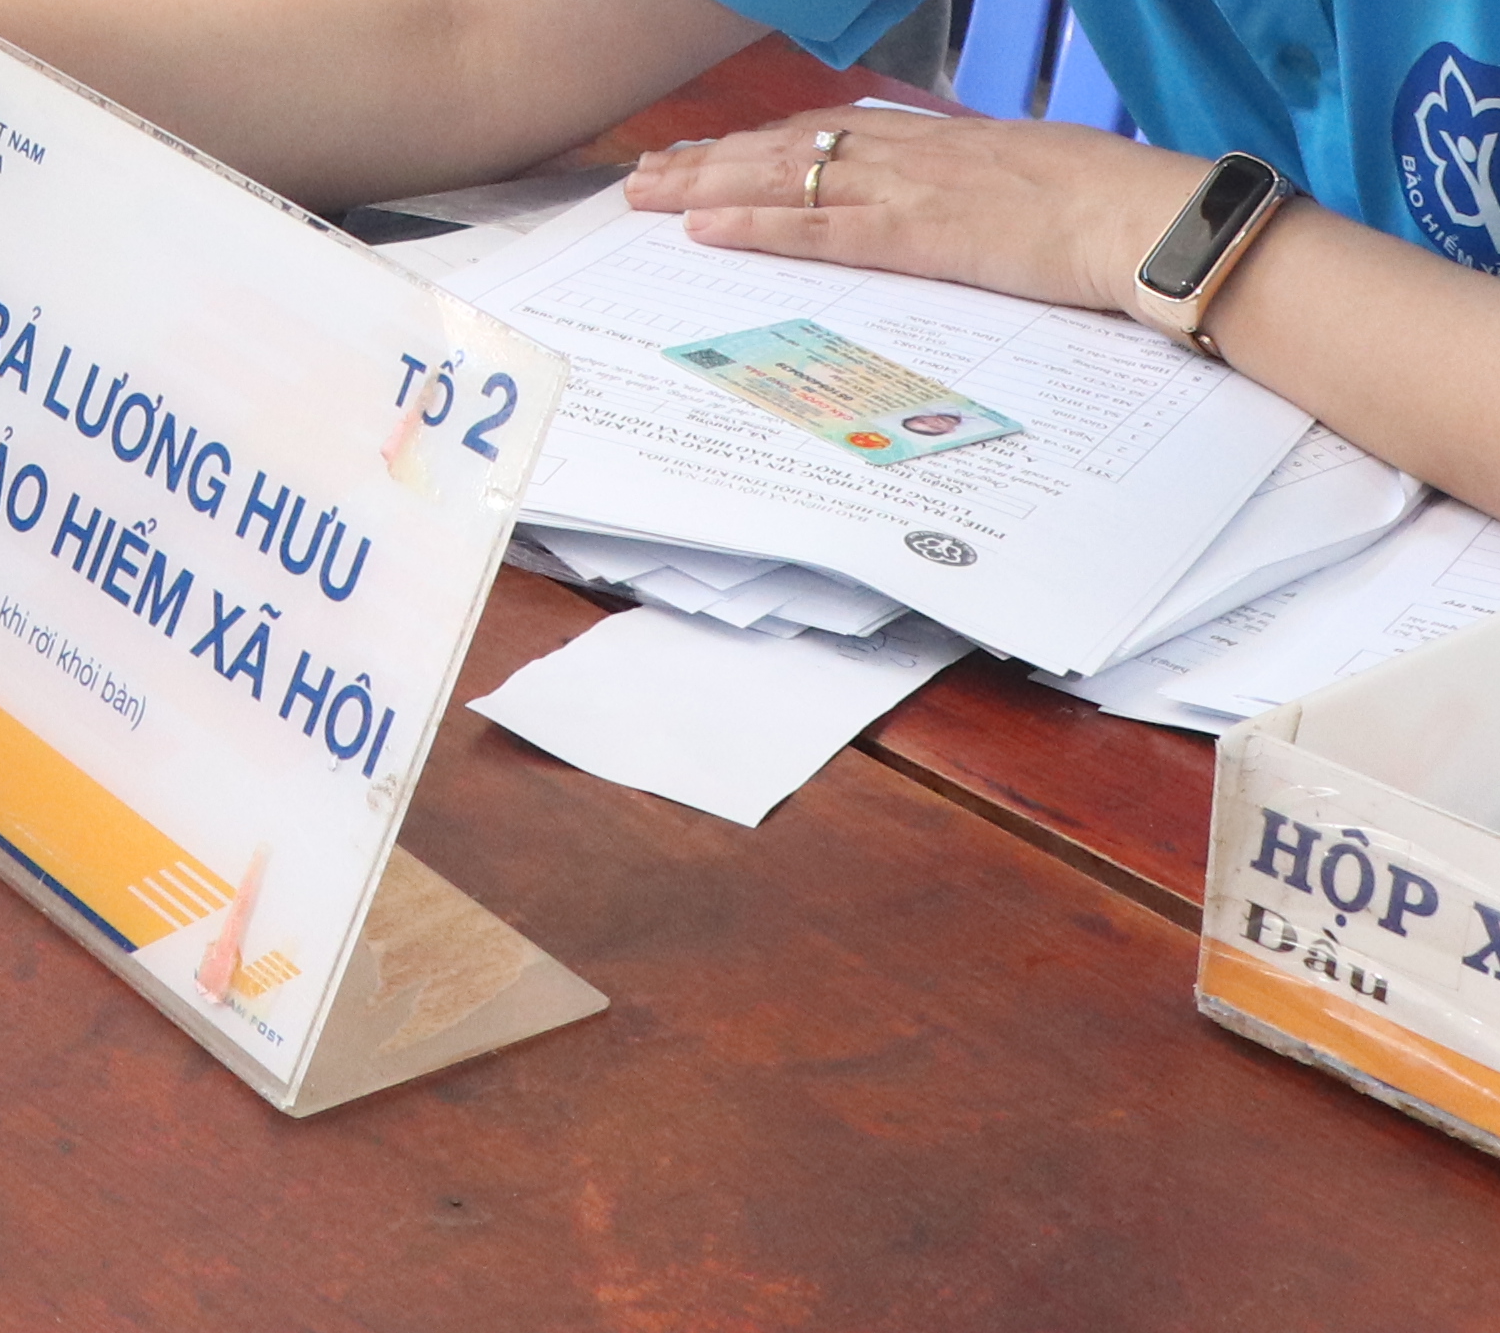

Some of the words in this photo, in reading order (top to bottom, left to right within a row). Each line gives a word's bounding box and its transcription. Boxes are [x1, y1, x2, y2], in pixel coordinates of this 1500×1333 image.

[7, 130, 45, 164] NAM
[44, 347, 230, 516] LƯƠNG
[236, 471, 370, 601] HƯU
[461, 372, 517, 461] 2
[27, 625, 57, 658] rời
[56, 639, 101, 690] khỏi
[100, 671, 145, 729] bàn)
[52, 494, 193, 635] HIỂM
[190, 589, 280, 700] XÃ
[279, 651, 394, 777] HỘI
[1250, 807, 1439, 937] HỘP
